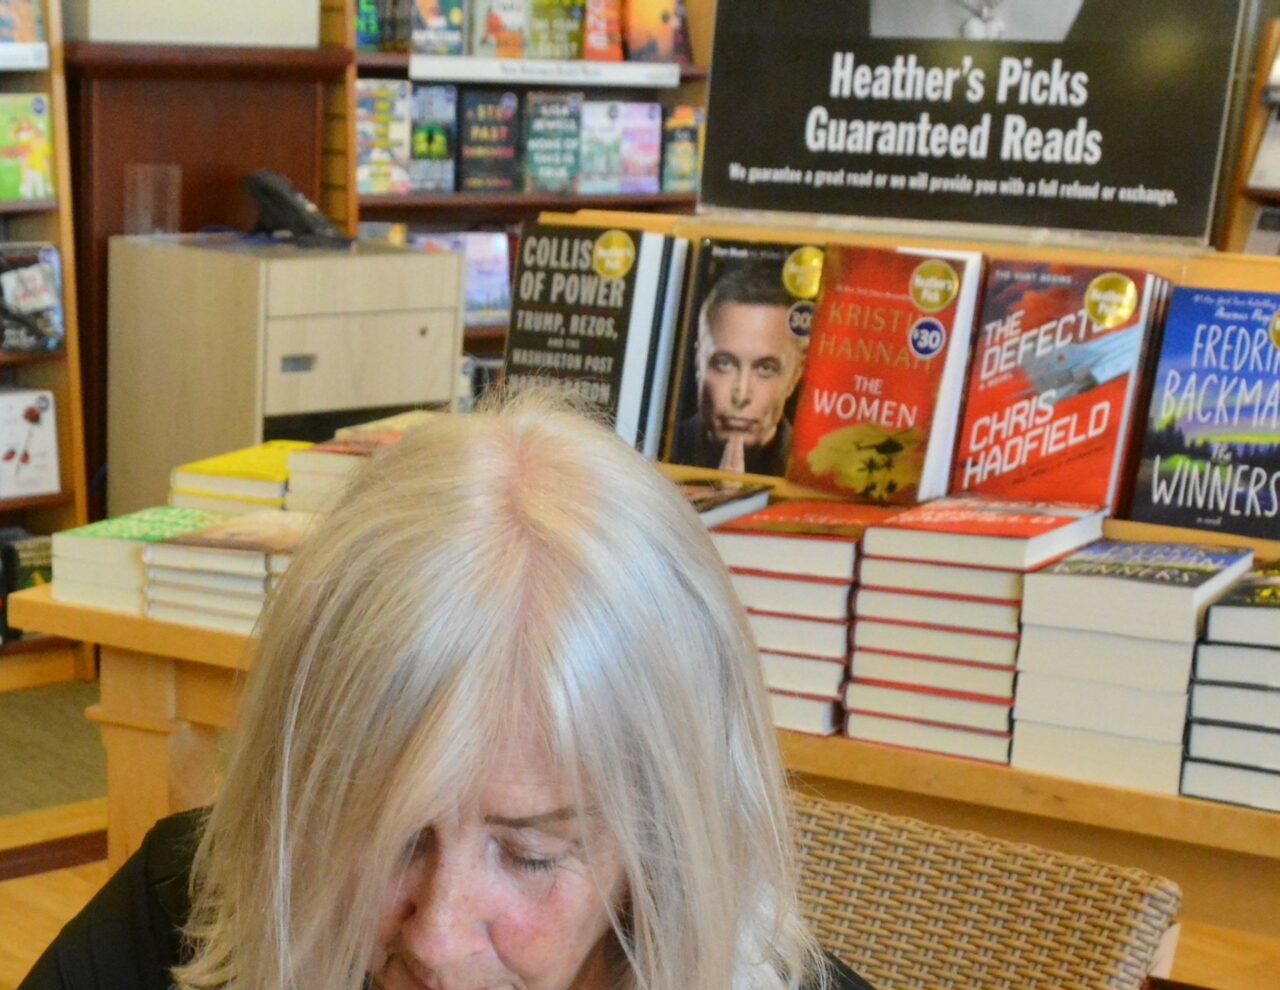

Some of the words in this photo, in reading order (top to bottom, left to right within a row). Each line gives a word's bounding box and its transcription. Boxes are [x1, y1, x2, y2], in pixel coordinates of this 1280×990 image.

[829, 51, 986, 104] Heather's
[995, 56, 1090, 107] Picks
[804, 105, 992, 160] Guaranteed
[999, 113, 1104, 165] Reads
[729, 162, 747, 181] We
[747, 166, 802, 186] guarantee
[804, 171, 813, 184] a
[813, 168, 845, 188] great
[846, 170, 873, 187] read
[874, 174, 888, 188] or
[889, 175, 906, 190] we
[907, 172, 928, 191] will
[928, 173, 973, 195] provide
[974, 178, 998, 196] you
[999, 177, 1025, 195] with
[1027, 182, 1036, 196] a
[1037, 178, 1058, 198] full
[1059, 180, 1100, 200] refund
[1101, 186, 1116, 200] or
[1117, 186, 1179, 206] exchange.
[523, 236, 596, 269] COLLIS
[520, 270, 546, 302] OF
[550, 272, 626, 309] POWER
[516, 309, 566, 336] TRUMP,
[569, 314, 619, 341] BEZOS,
[828, 301, 917, 338] KRISTI
[912, 327, 941, 350] $30
[984, 310, 1026, 348] THE
[512, 348, 583, 370] WASHINGTON
[583, 355, 614, 373] POST
[980, 308, 1108, 381] DEFECT
[854, 373, 885, 397] THE
[1161, 369, 1280, 430] BACKMA
[812, 388, 919, 429] WOMEN
[970, 388, 1058, 452] CHRIS
[962, 400, 1112, 491] HADFIELD
[1151, 454, 1280, 518] WINNERS
